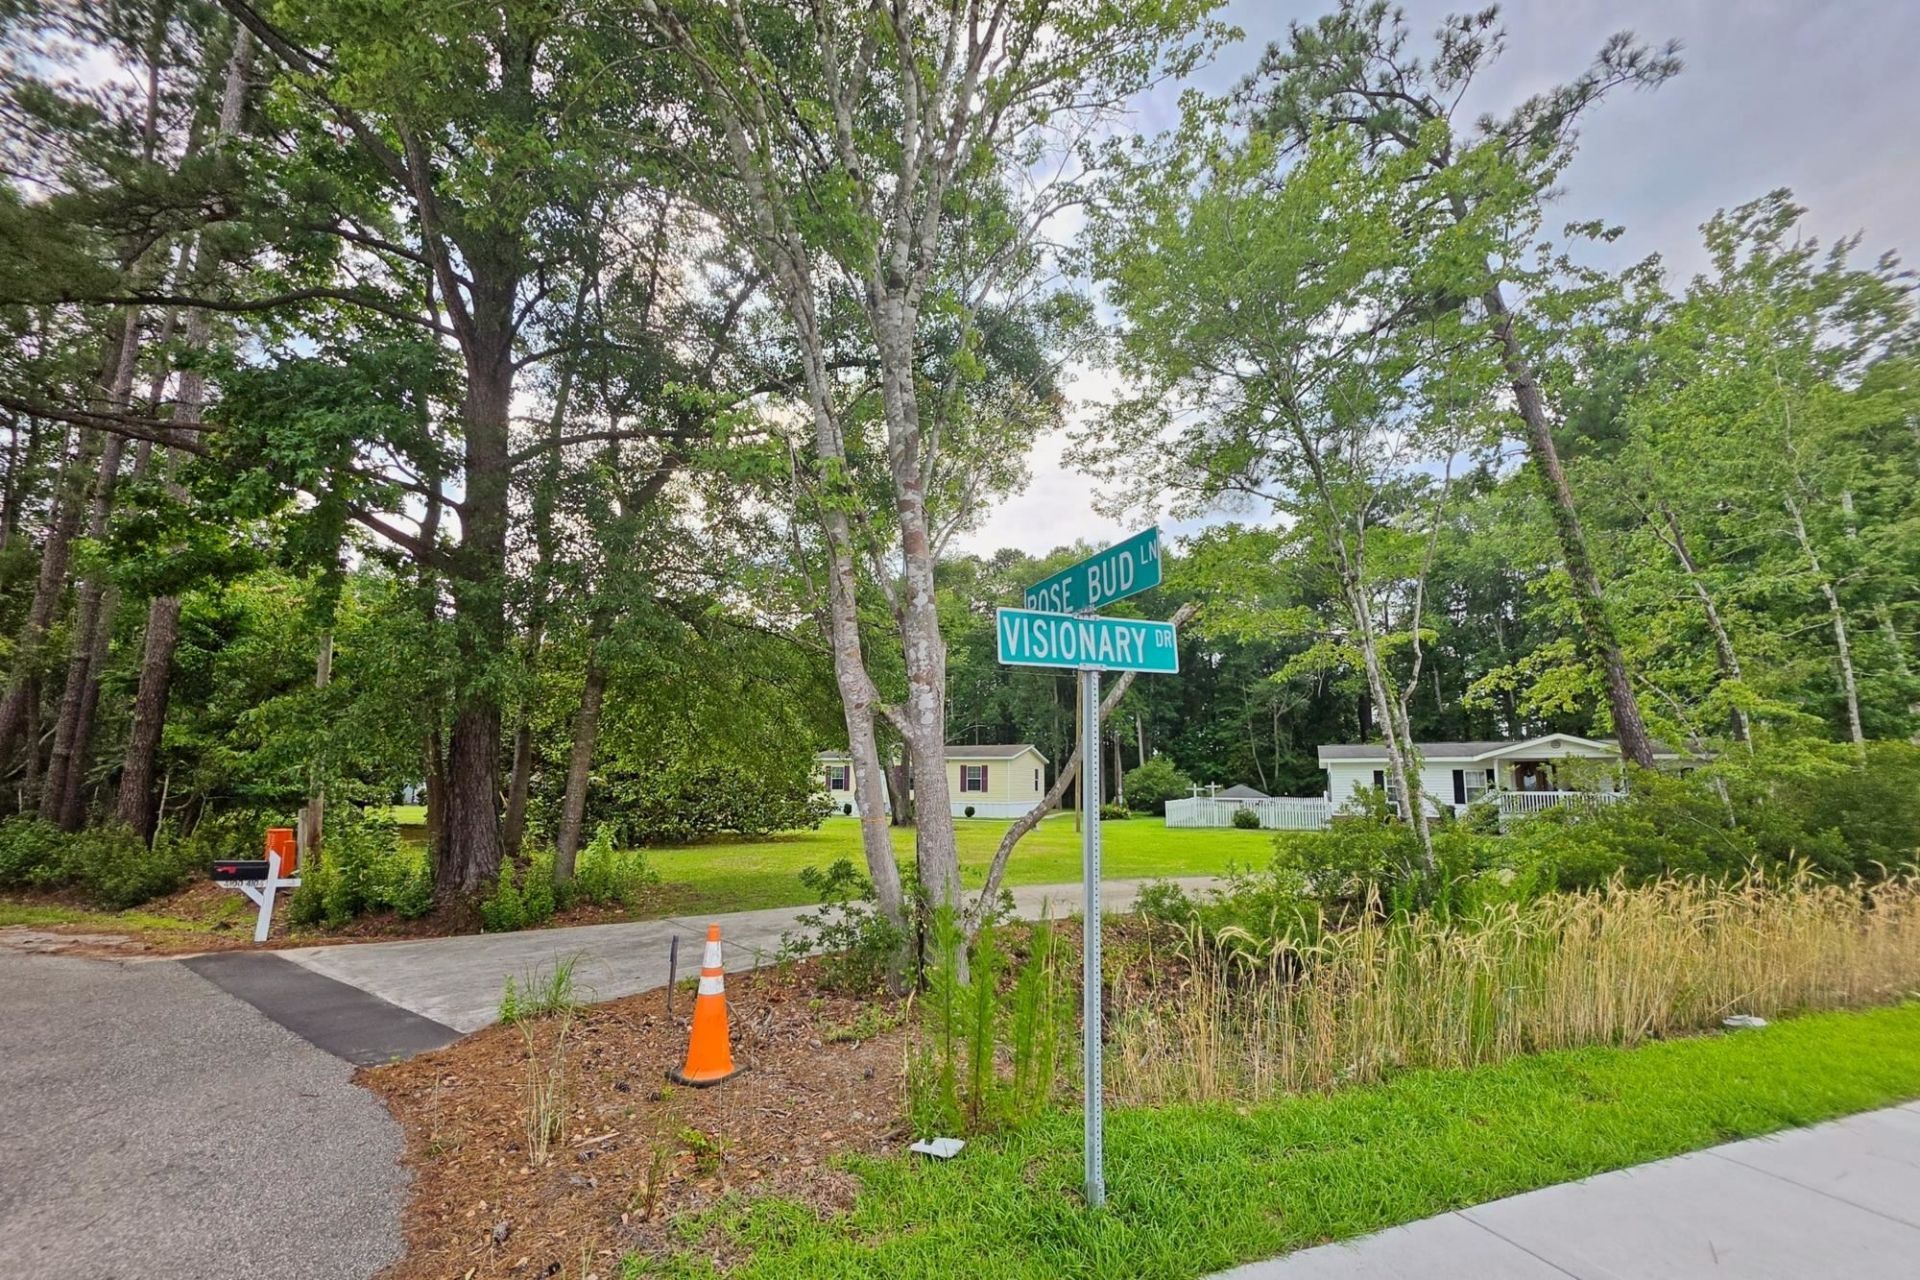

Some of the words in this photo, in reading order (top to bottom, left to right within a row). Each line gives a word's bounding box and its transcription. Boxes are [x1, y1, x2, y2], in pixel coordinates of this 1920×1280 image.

[1088, 551, 1134, 604] BUD
[1140, 538, 1157, 565] LN
[1002, 616, 1147, 664] VISIONARY
[1155, 629, 1173, 648] DR
